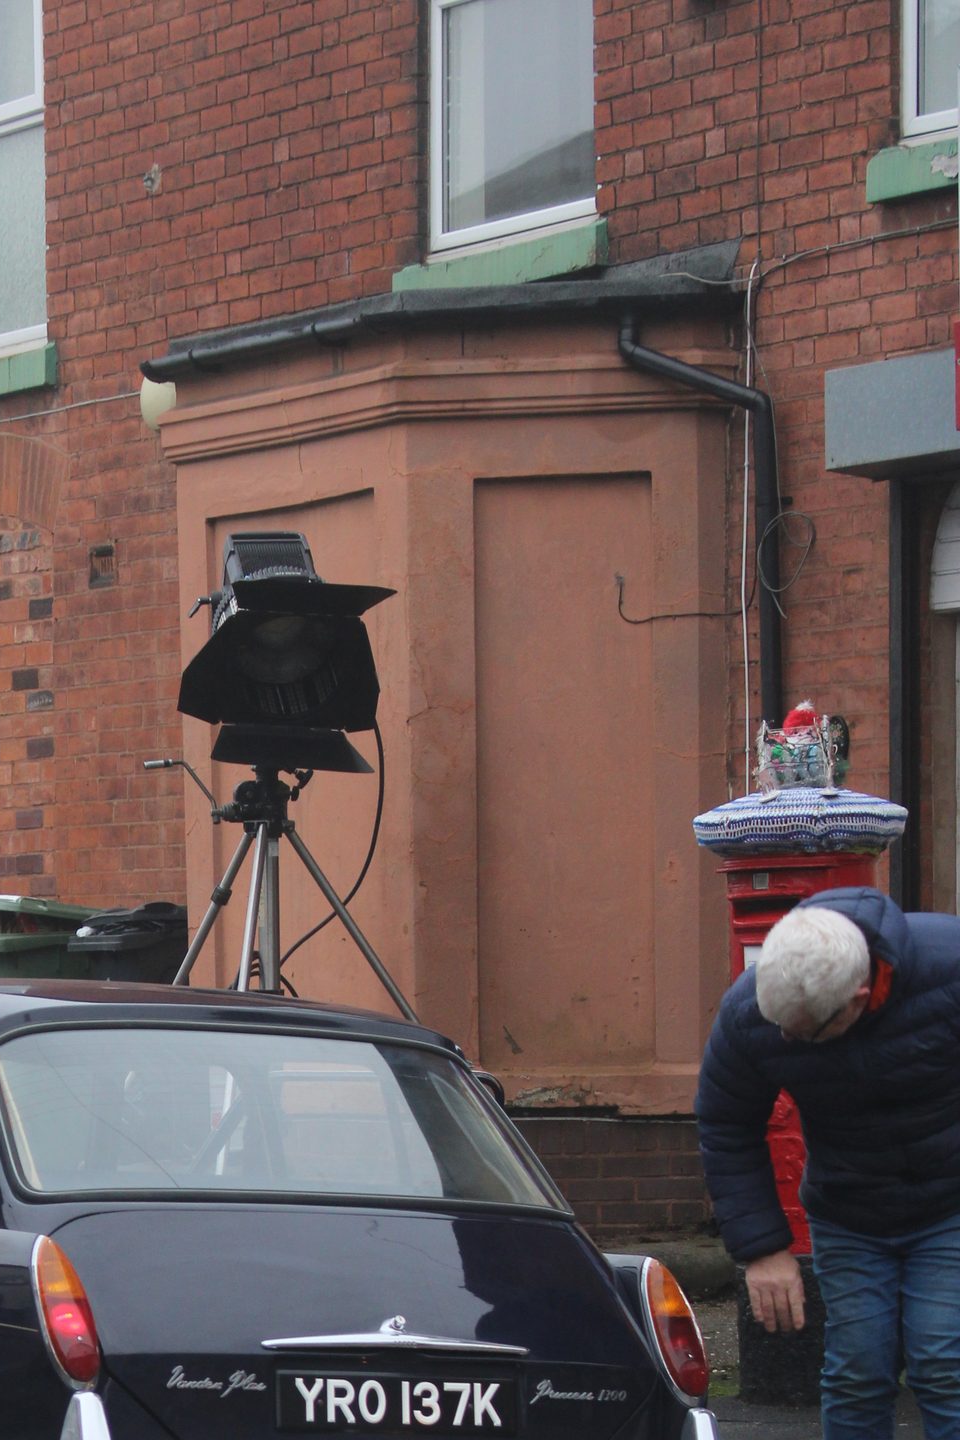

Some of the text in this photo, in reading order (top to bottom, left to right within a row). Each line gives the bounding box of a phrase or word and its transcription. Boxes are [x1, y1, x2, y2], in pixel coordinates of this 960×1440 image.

[166, 1365, 267, 1398] Vanden Plas
[529, 1379, 595, 1404] Princess
[295, 1378, 502, 1427] YRO 137K
